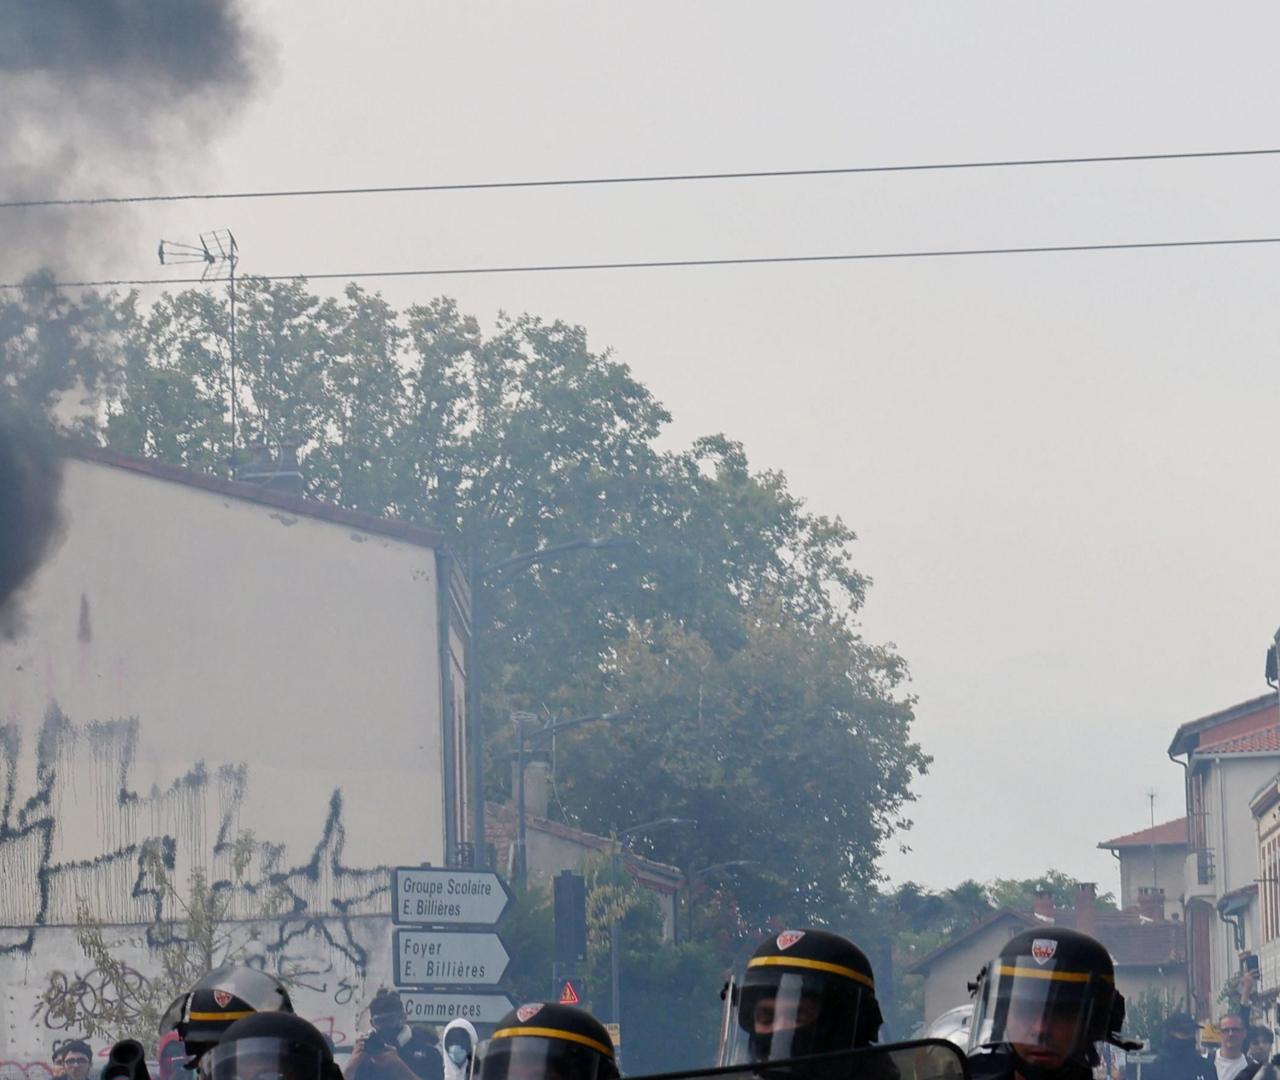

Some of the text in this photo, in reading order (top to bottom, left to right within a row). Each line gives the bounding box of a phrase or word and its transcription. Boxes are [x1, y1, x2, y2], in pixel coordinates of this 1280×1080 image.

[403, 877, 492, 898] Groupe Scolaire
[403, 900, 461, 917] E. Billières
[404, 938, 442, 958] Foyer
[404, 960, 485, 978] E. Billières
[405, 999, 481, 1017] Commerces
